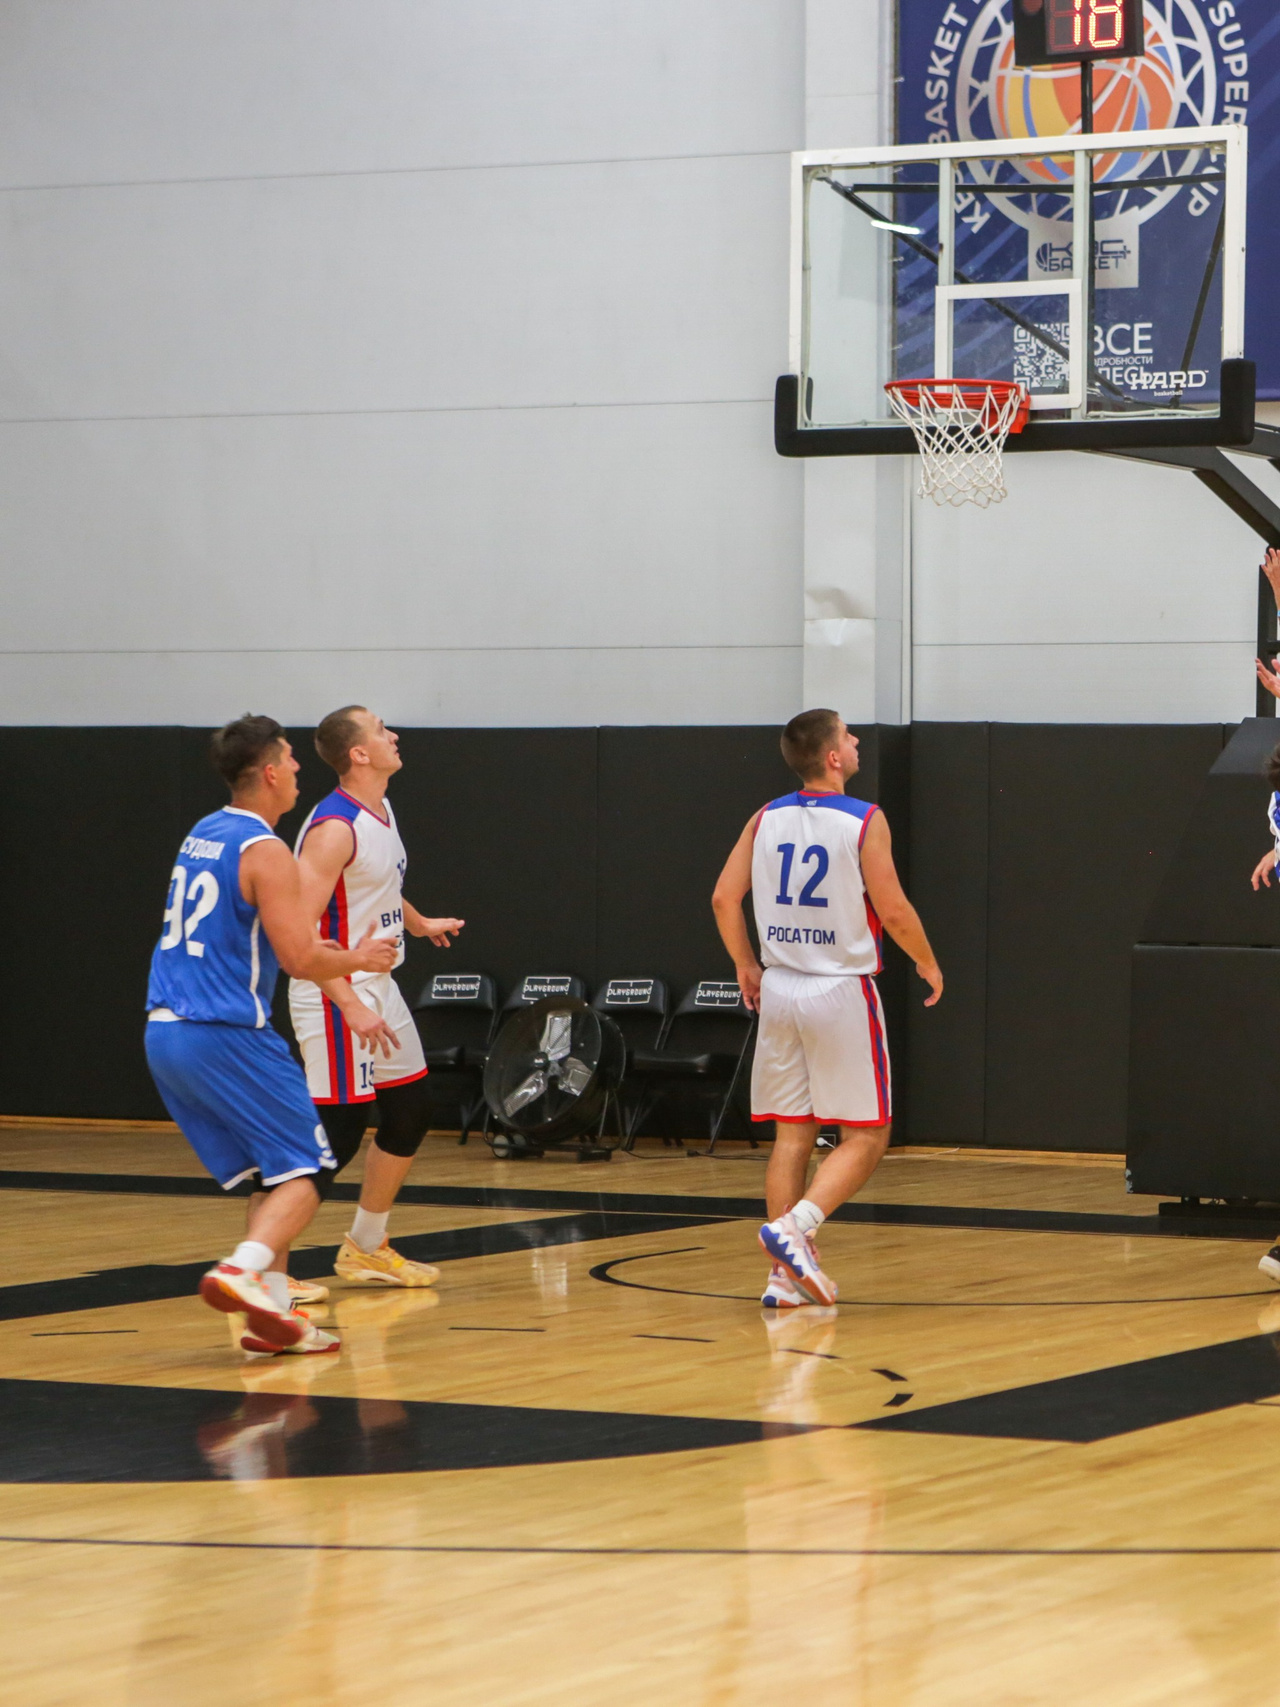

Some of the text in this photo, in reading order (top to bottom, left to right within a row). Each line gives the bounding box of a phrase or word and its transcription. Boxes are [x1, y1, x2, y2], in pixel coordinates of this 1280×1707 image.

[925, 3, 969, 143] BASKET
[1209, 0, 1249, 126] SUPER
[1094, 356, 1153, 367] ДРОБНОСТИ
[1130, 370, 1206, 390] HARD
[1153, 389, 1183, 397] basketball
[775, 842, 829, 908] 12
[160, 865, 219, 958] 92
[767, 925, 836, 945] РОСАТОМ
[433, 981, 480, 992] PLAYGROUND
[523, 982, 570, 993] PLAYGROUND
[606, 986, 652, 997] PLAYGROUND
